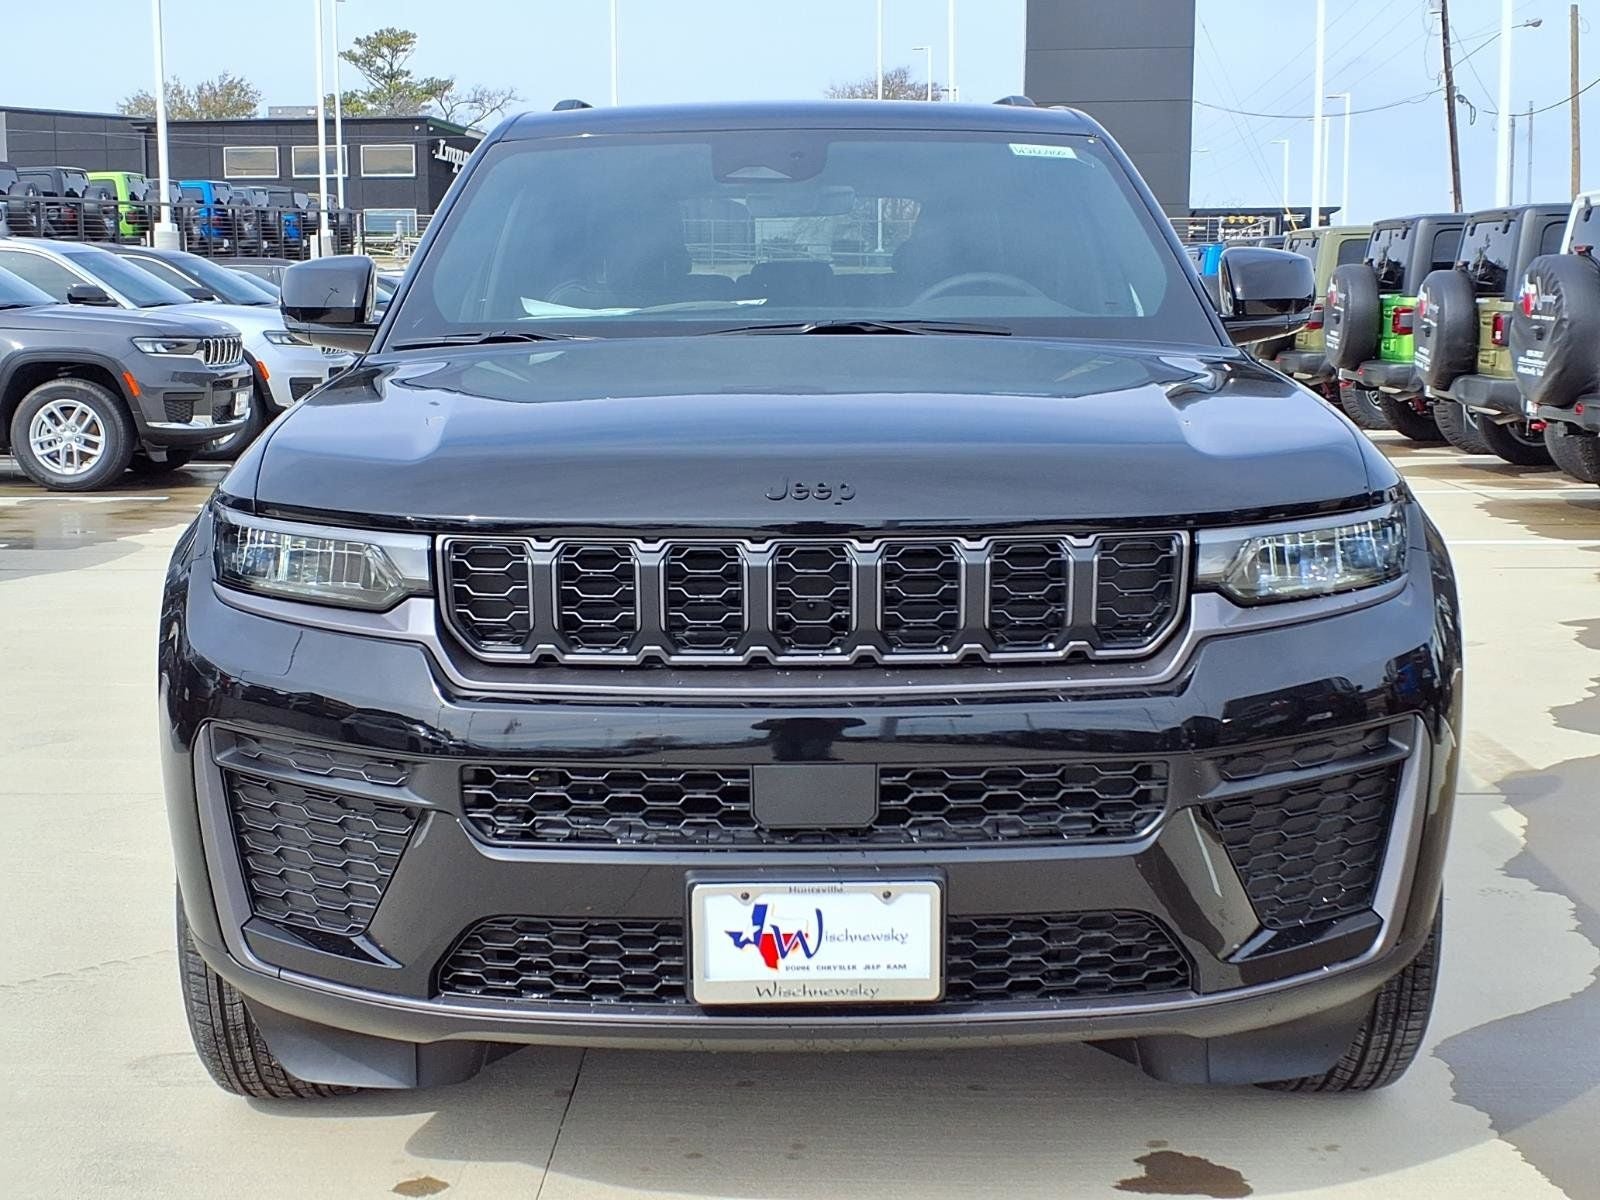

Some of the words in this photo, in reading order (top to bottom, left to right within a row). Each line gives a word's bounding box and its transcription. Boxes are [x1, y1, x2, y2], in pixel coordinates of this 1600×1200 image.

[763, 476, 856, 505] Jeep
[788, 885, 844, 894] Huntsville
[755, 981, 880, 998] Wischnewsky
